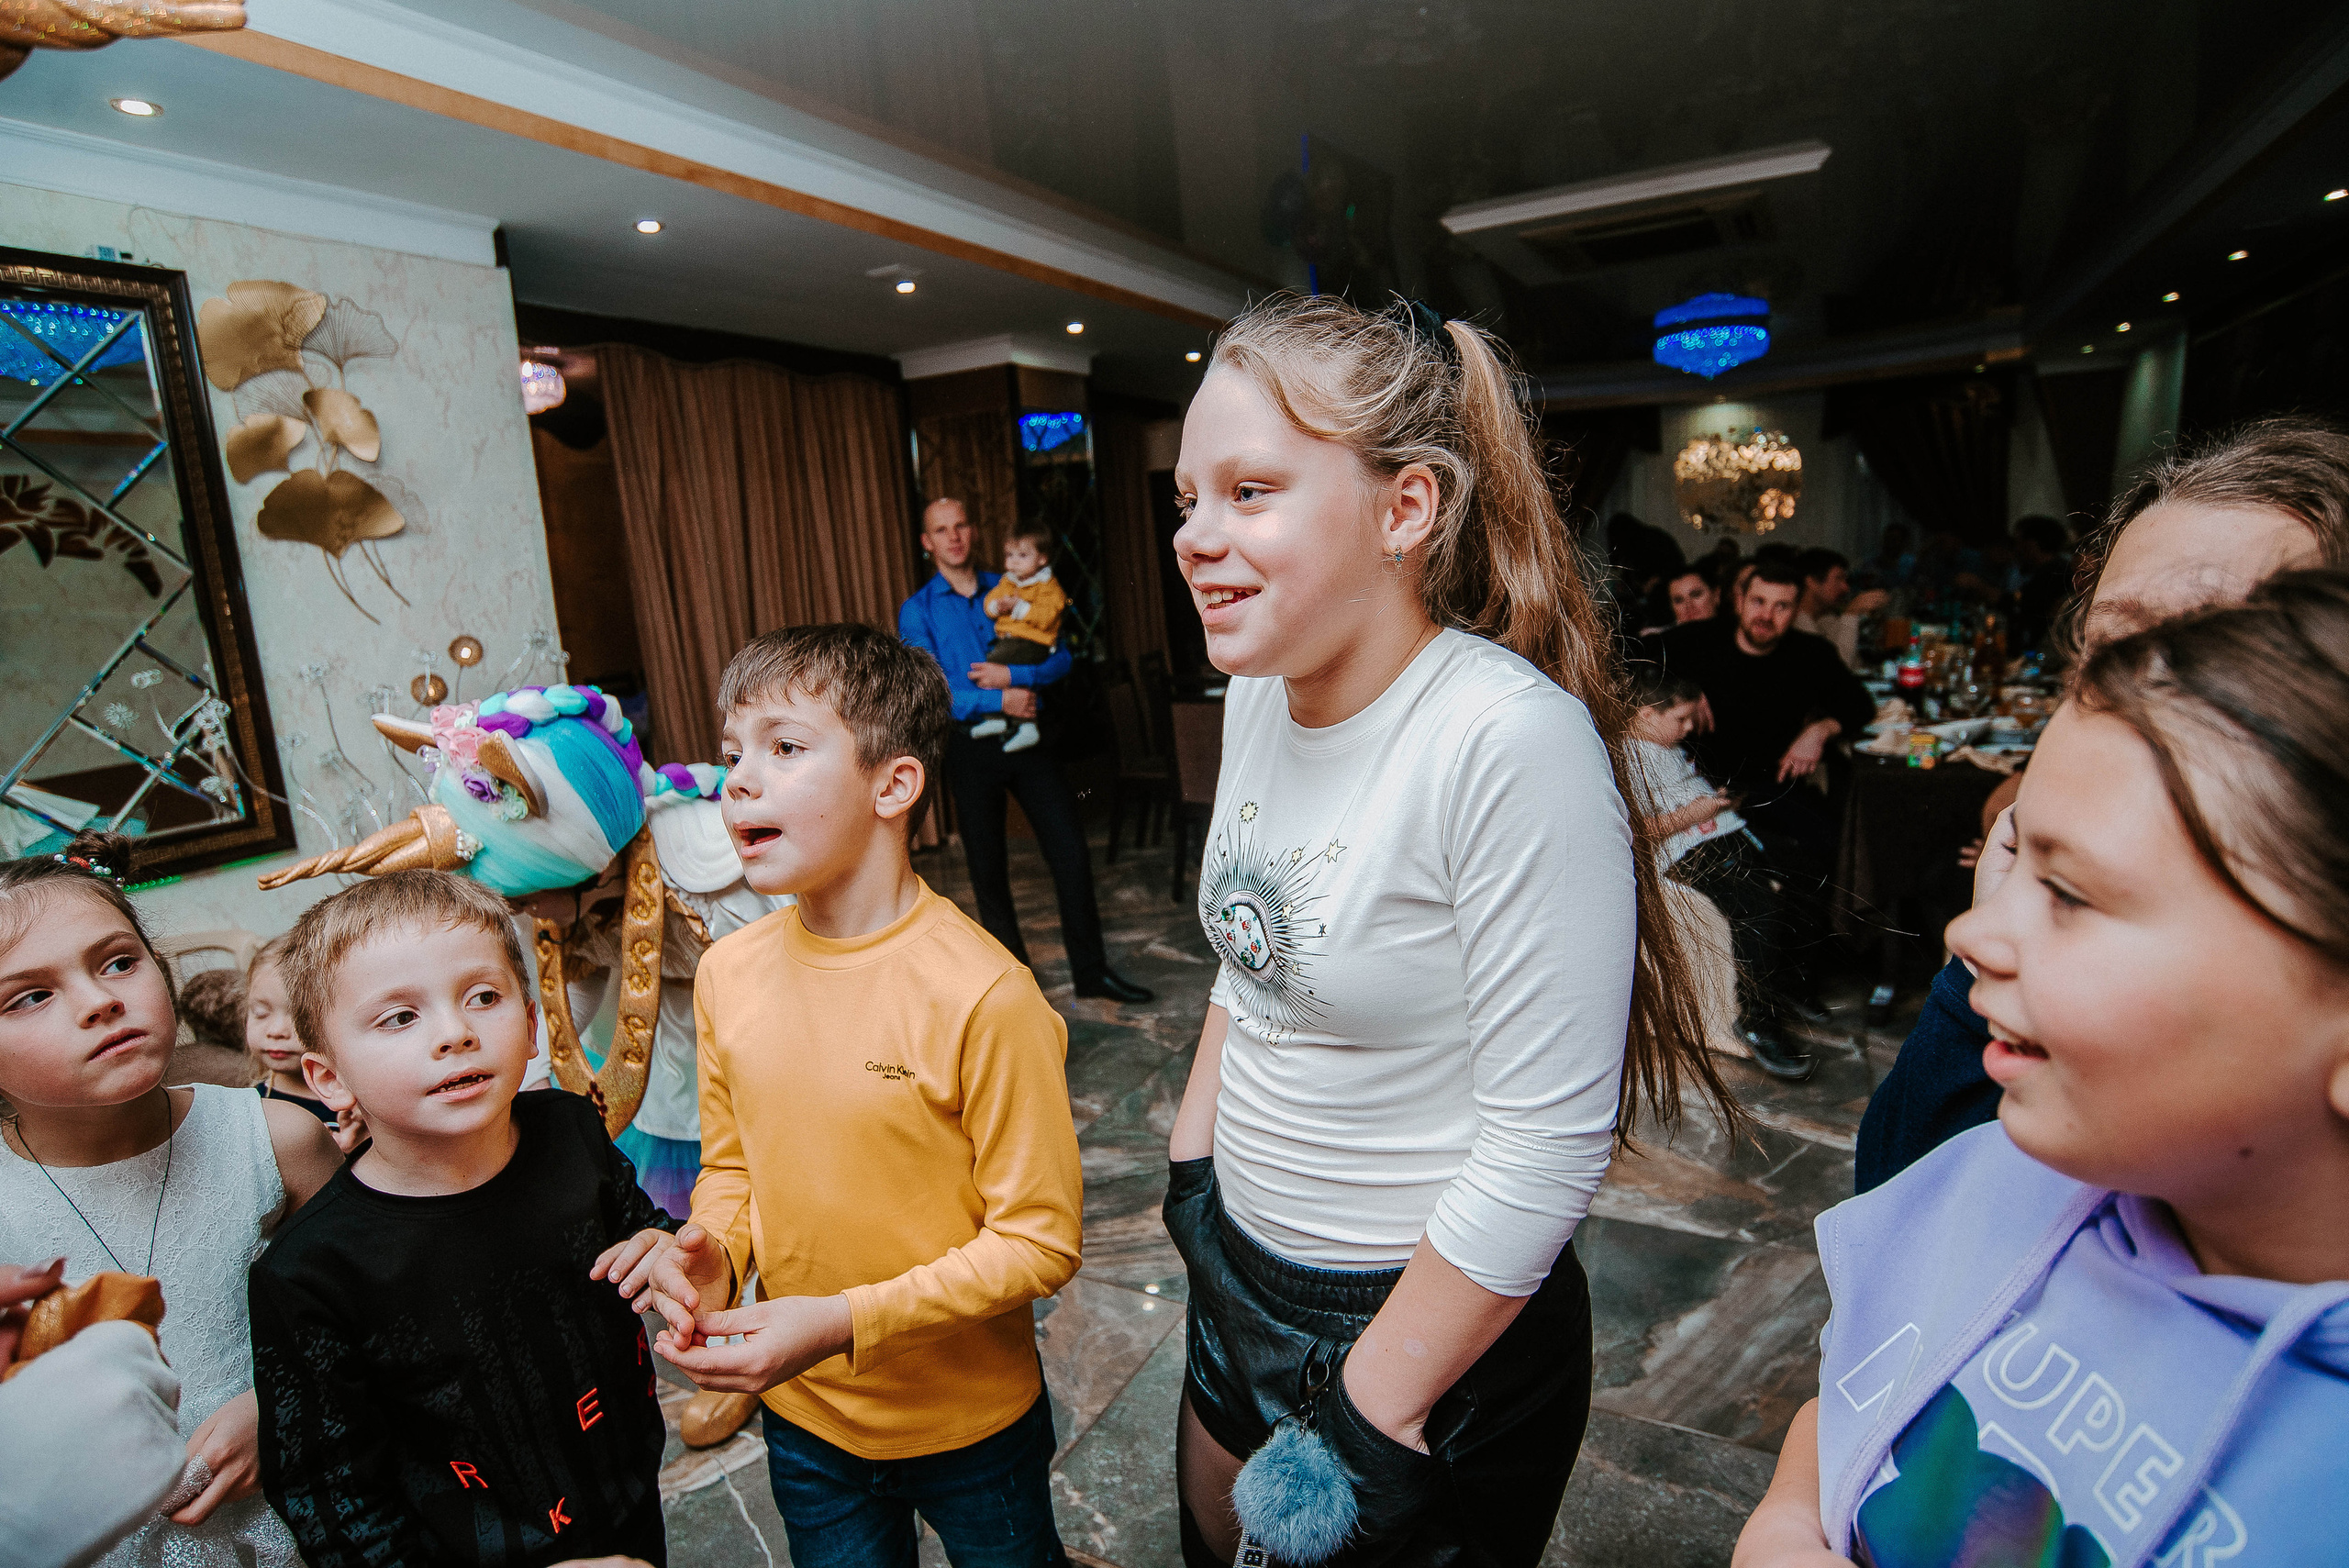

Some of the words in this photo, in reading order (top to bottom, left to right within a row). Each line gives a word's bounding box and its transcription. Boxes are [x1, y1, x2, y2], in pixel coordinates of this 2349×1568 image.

[865, 1062, 896, 1074] Calvin
[896, 1064, 916, 1079] Klein
[576, 1387, 605, 1431] E
[450, 1461, 489, 1489] R
[549, 1496, 573, 1534] K
